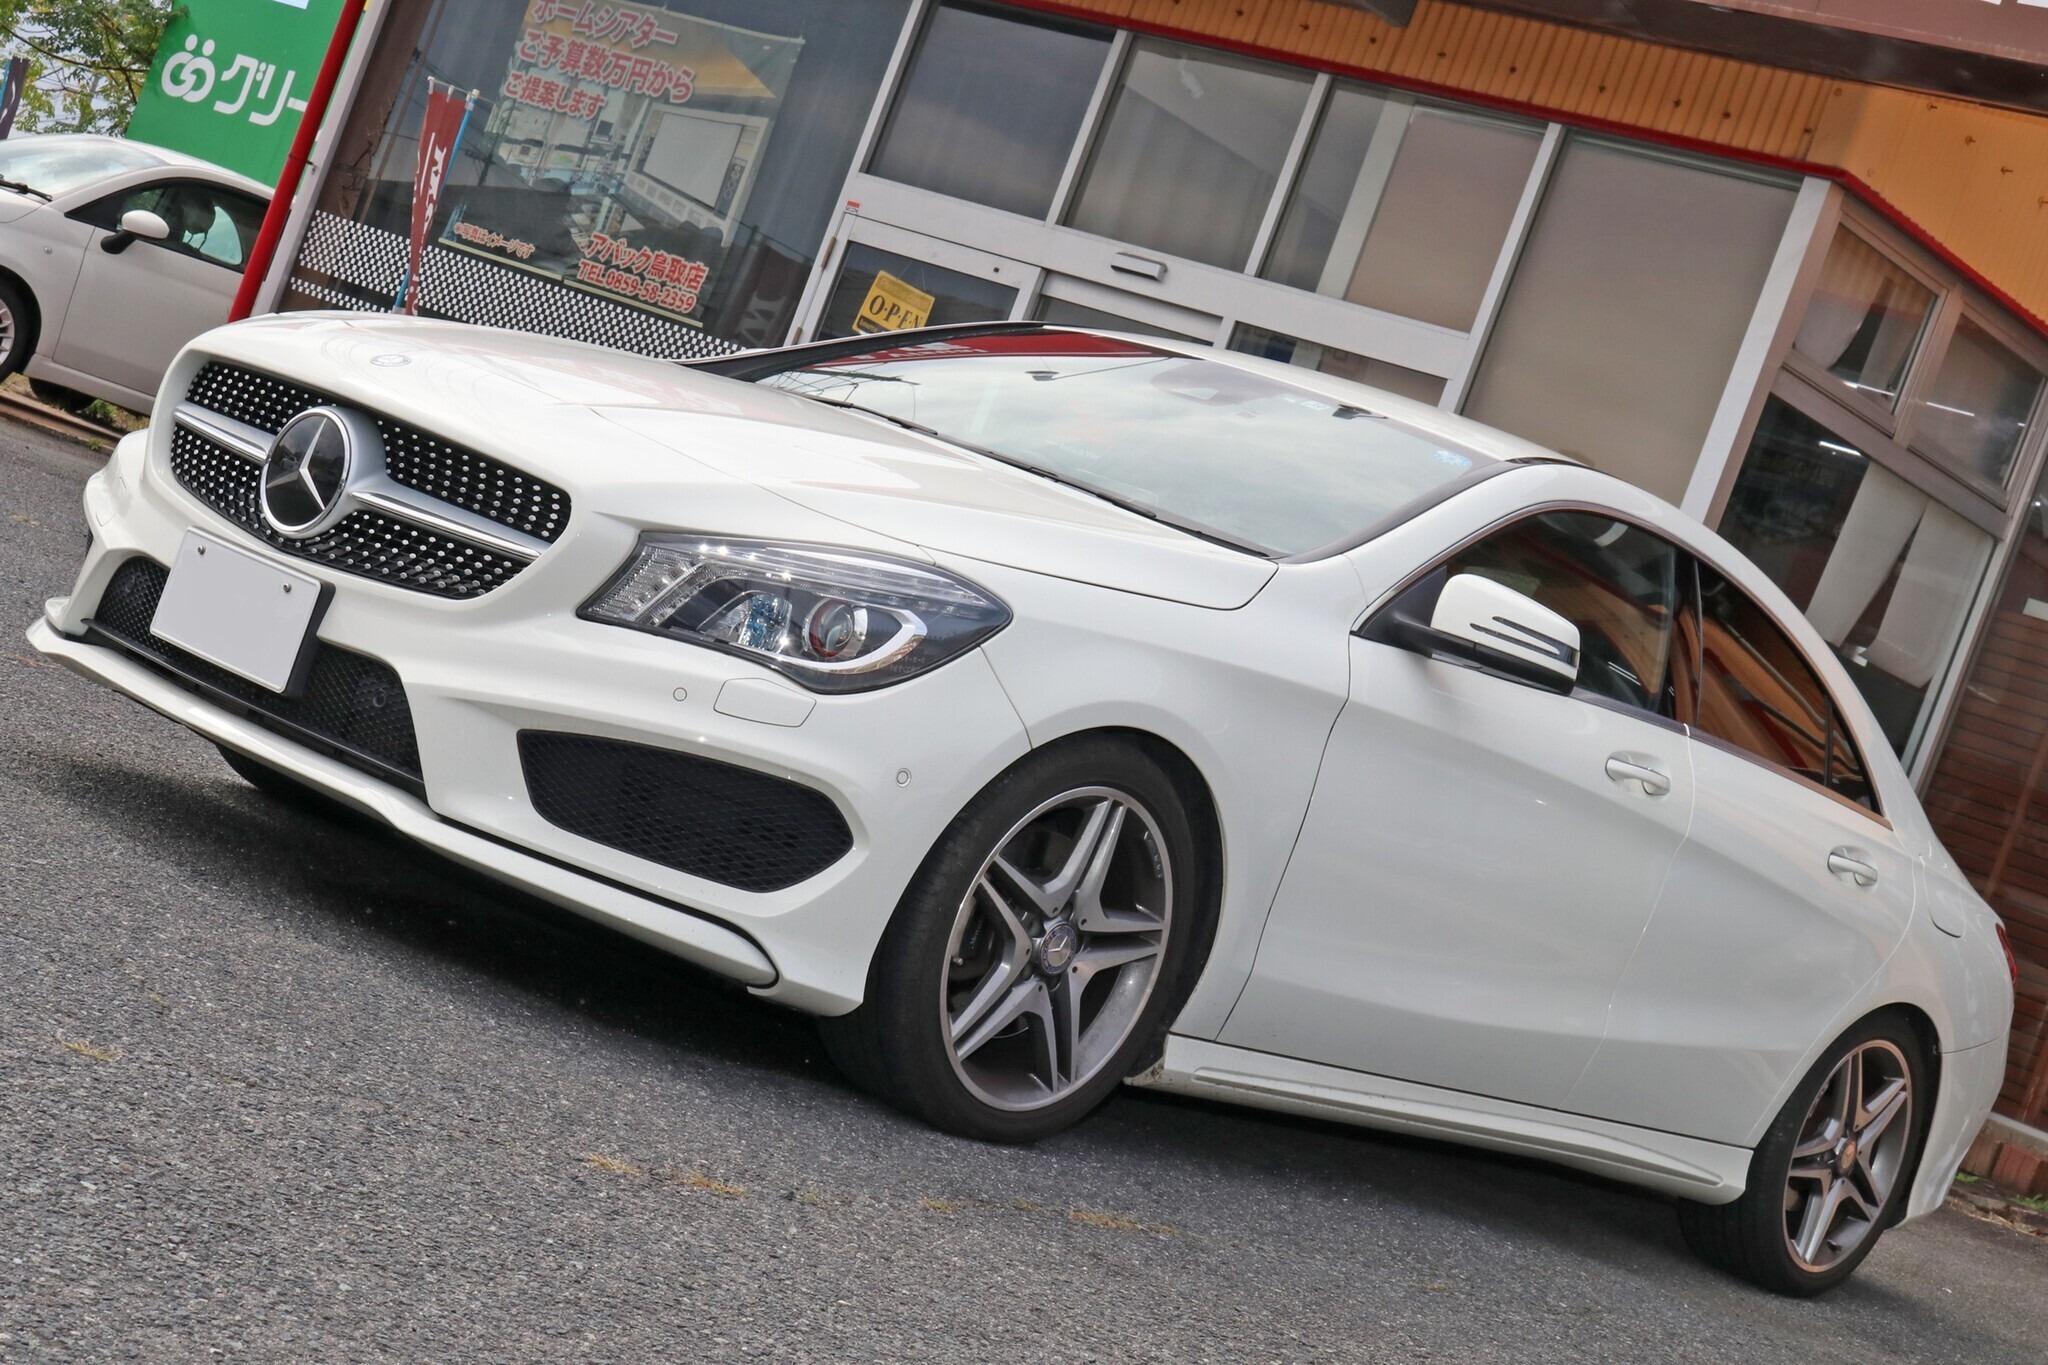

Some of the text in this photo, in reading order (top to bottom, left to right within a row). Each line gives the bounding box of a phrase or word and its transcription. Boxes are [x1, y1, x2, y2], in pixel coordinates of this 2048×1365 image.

[518, 28, 697, 103] ご予算数万円から
[504, 71, 608, 120] ご提案します
[576, 258, 697, 313] TEL 0859-58-2359
[584, 232, 709, 294] アバック鳥取店
